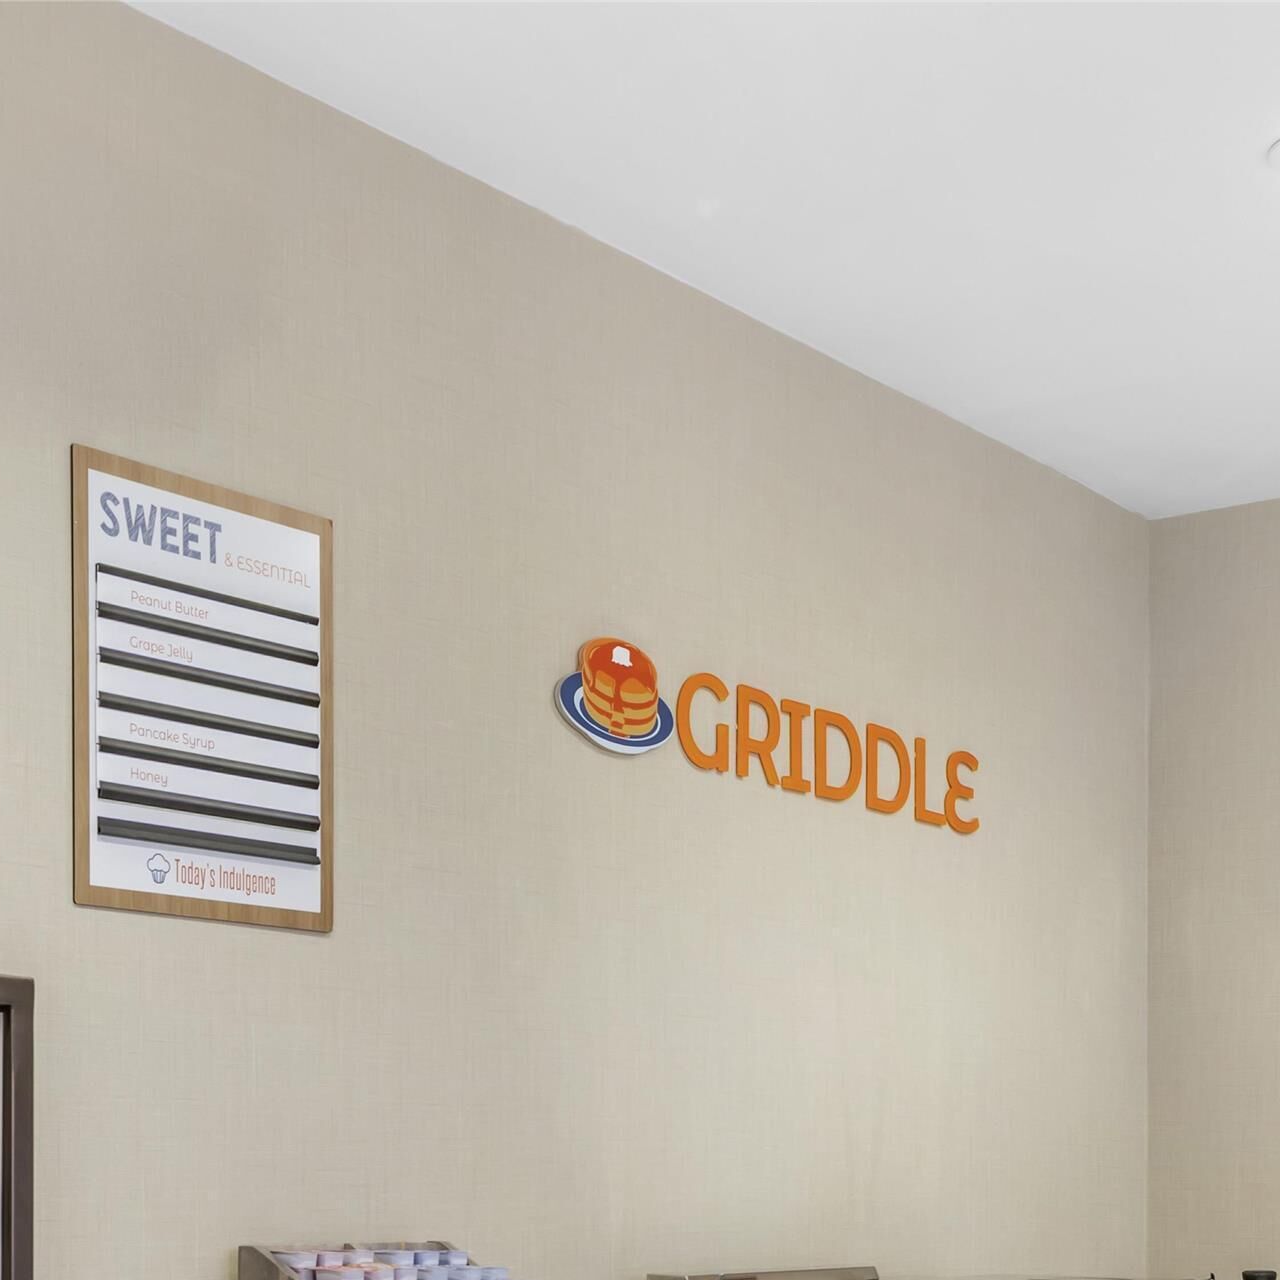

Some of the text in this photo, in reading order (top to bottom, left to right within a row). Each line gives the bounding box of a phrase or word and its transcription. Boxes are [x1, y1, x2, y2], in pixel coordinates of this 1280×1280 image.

[99, 491, 312, 589] SWEET & ESSENTIAL
[130, 590, 209, 620] Peanut Butter
[128, 635, 193, 663] Grape Jelly
[129, 722, 216, 752] Pancake Syrup
[676, 672, 980, 835] GRIDDLE
[129, 767, 169, 787] Honey
[174, 858, 276, 896] Today's Indulgence
